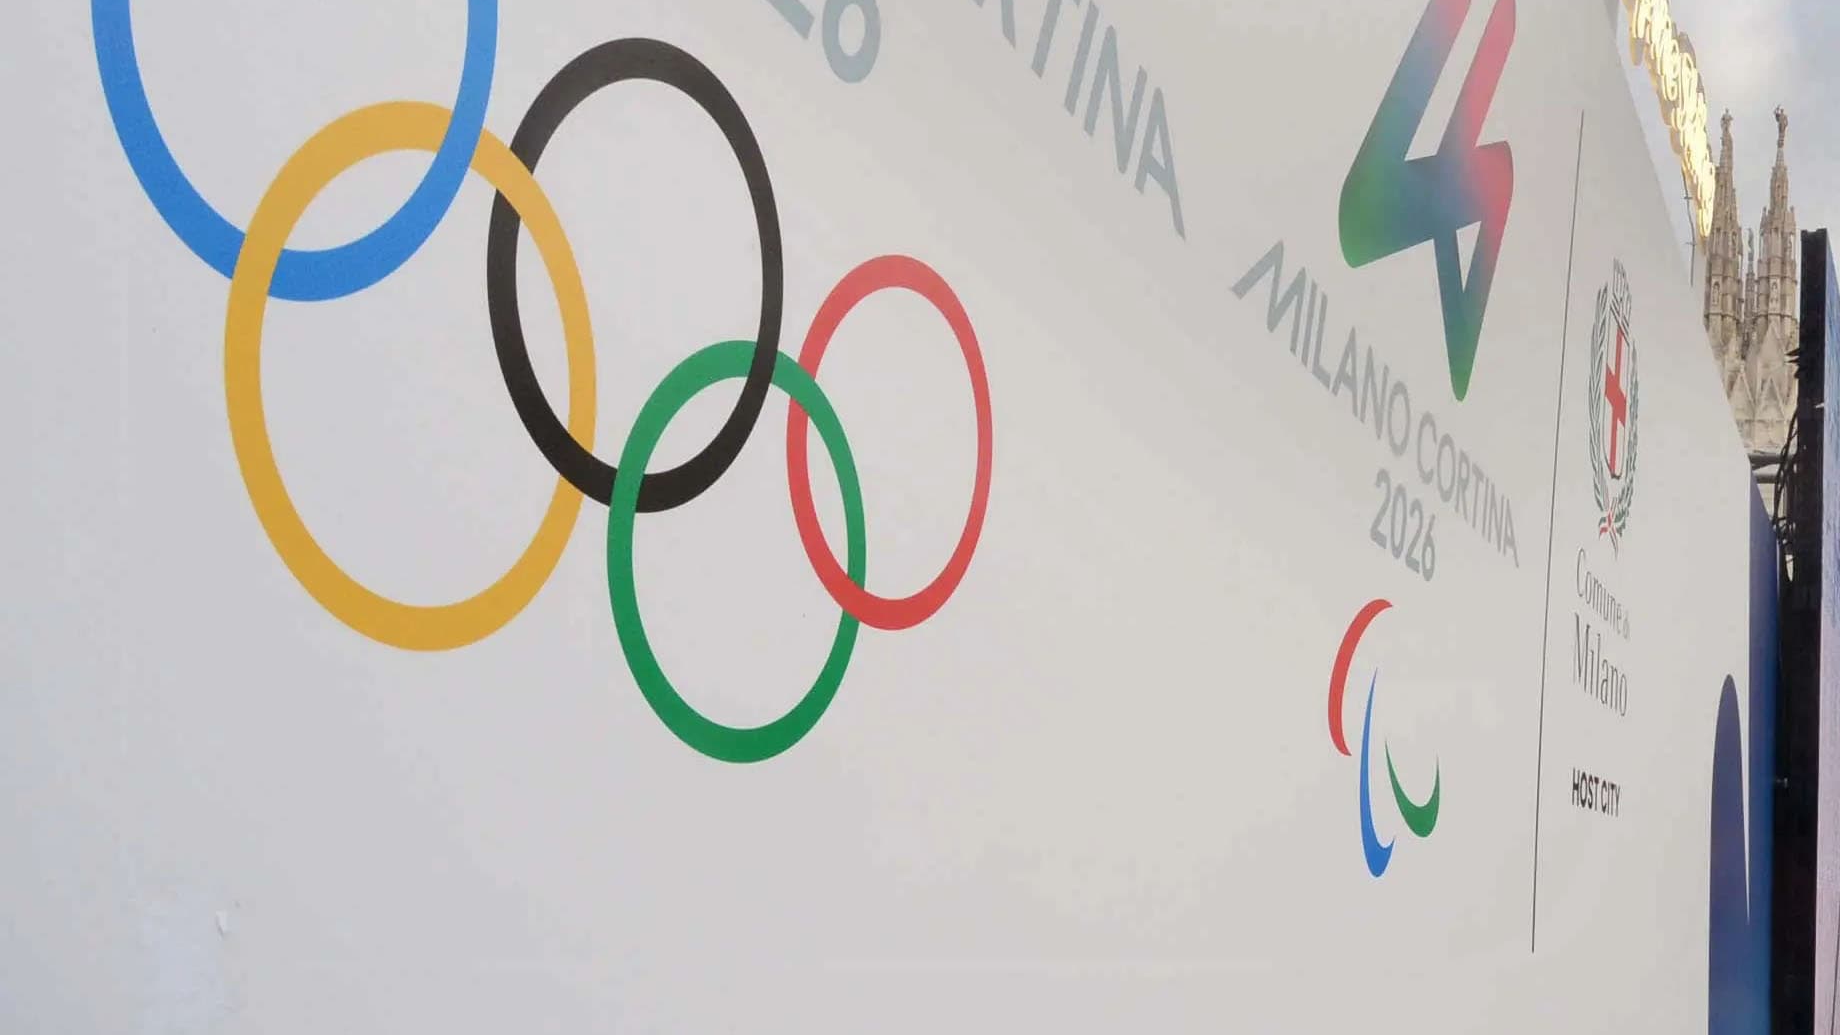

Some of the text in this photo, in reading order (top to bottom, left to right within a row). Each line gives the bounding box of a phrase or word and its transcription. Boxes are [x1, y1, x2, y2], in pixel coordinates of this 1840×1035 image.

[1232, 240, 1520, 569] MILANO CORTINA
[1370, 468, 1436, 582] 2026
[1576, 547, 1622, 636] Comune
[1573, 612, 1628, 717] Milano
[1571, 767, 1621, 818] HOST CITY
